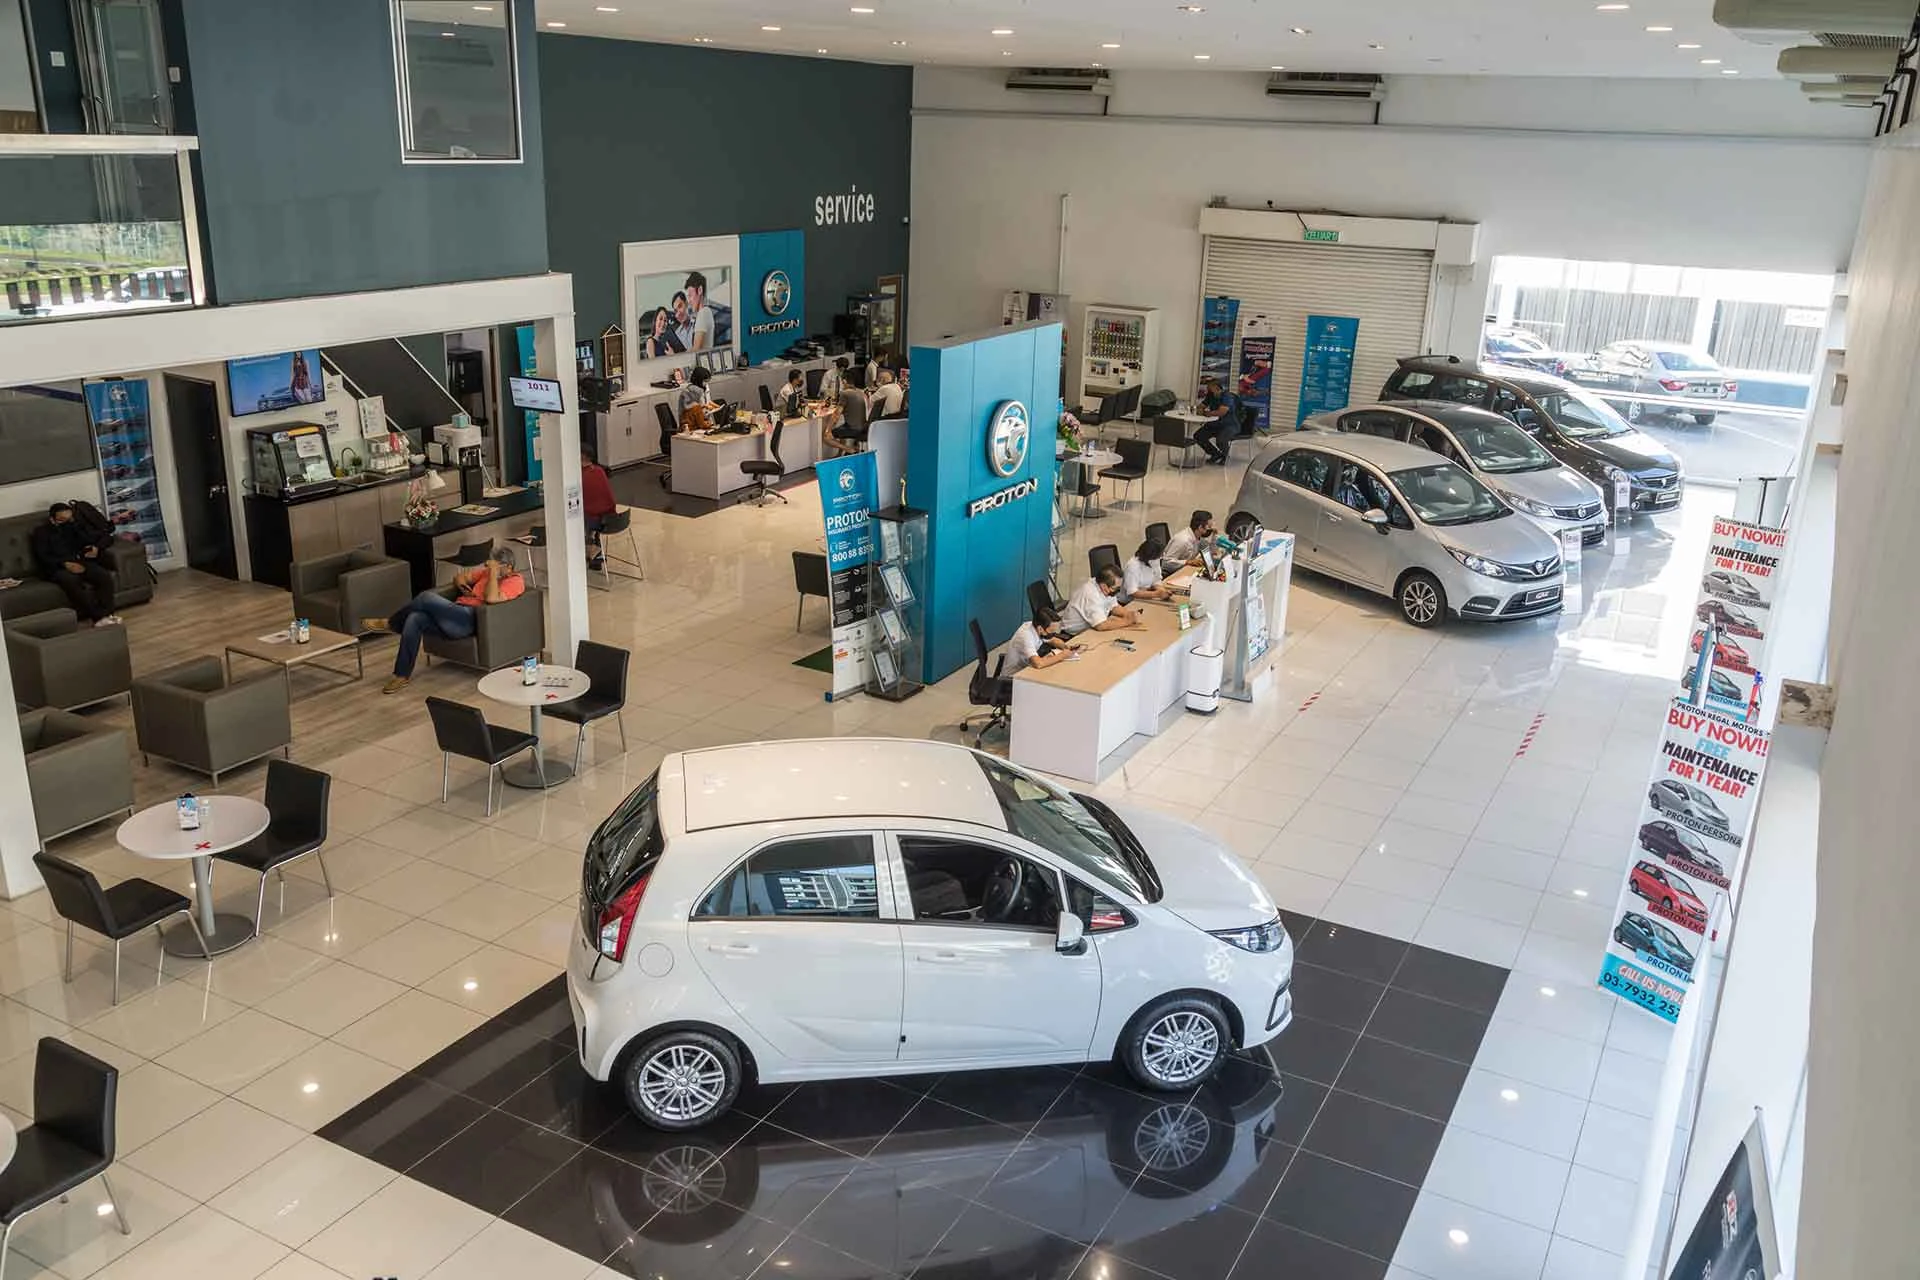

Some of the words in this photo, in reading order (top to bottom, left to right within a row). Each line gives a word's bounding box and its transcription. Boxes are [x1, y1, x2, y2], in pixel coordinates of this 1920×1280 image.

[815, 184, 874, 226] service
[751, 319, 799, 336] PROTON
[528, 382, 550, 392] 1011
[971, 478, 1038, 518] PROTON
[827, 507, 870, 530] PROTON
[1714, 523, 1740, 538] BUY
[1742, 529, 1785, 547] NOW!!
[1711, 545, 1779, 568] MAINTENANCE
[1715, 557, 1733, 569] FOR
[1743, 563, 1771, 577] YEAR!
[1668, 708, 1705, 733] BUY
[1707, 722, 1769, 757] NOW!!
[1677, 702, 1706, 717] PROTON
[1708, 712, 1730, 726] REGAL
[1732, 721, 1763, 736] MOTORS
[1695, 738, 1730, 760] FREE
[1663, 740, 1758, 786] MAINTENANCE
[1668, 759, 1694, 779] FOR
[1696, 769, 1704, 782] 1
[1706, 771, 1747, 798] YEAR!
[1666, 809, 1701, 830] PROTON
[1703, 824, 1741, 846] PERSONA
[1672, 859, 1706, 879] PROTON
[1708, 875, 1729, 889] SAGA
[1653, 904, 1686, 925] PROTON
[1618, 964, 1640, 982] CALL
[1641, 975, 1657, 991] US
[1647, 956, 1682, 979] PROTON
[1603, 972, 1656, 1006] 03-7932
